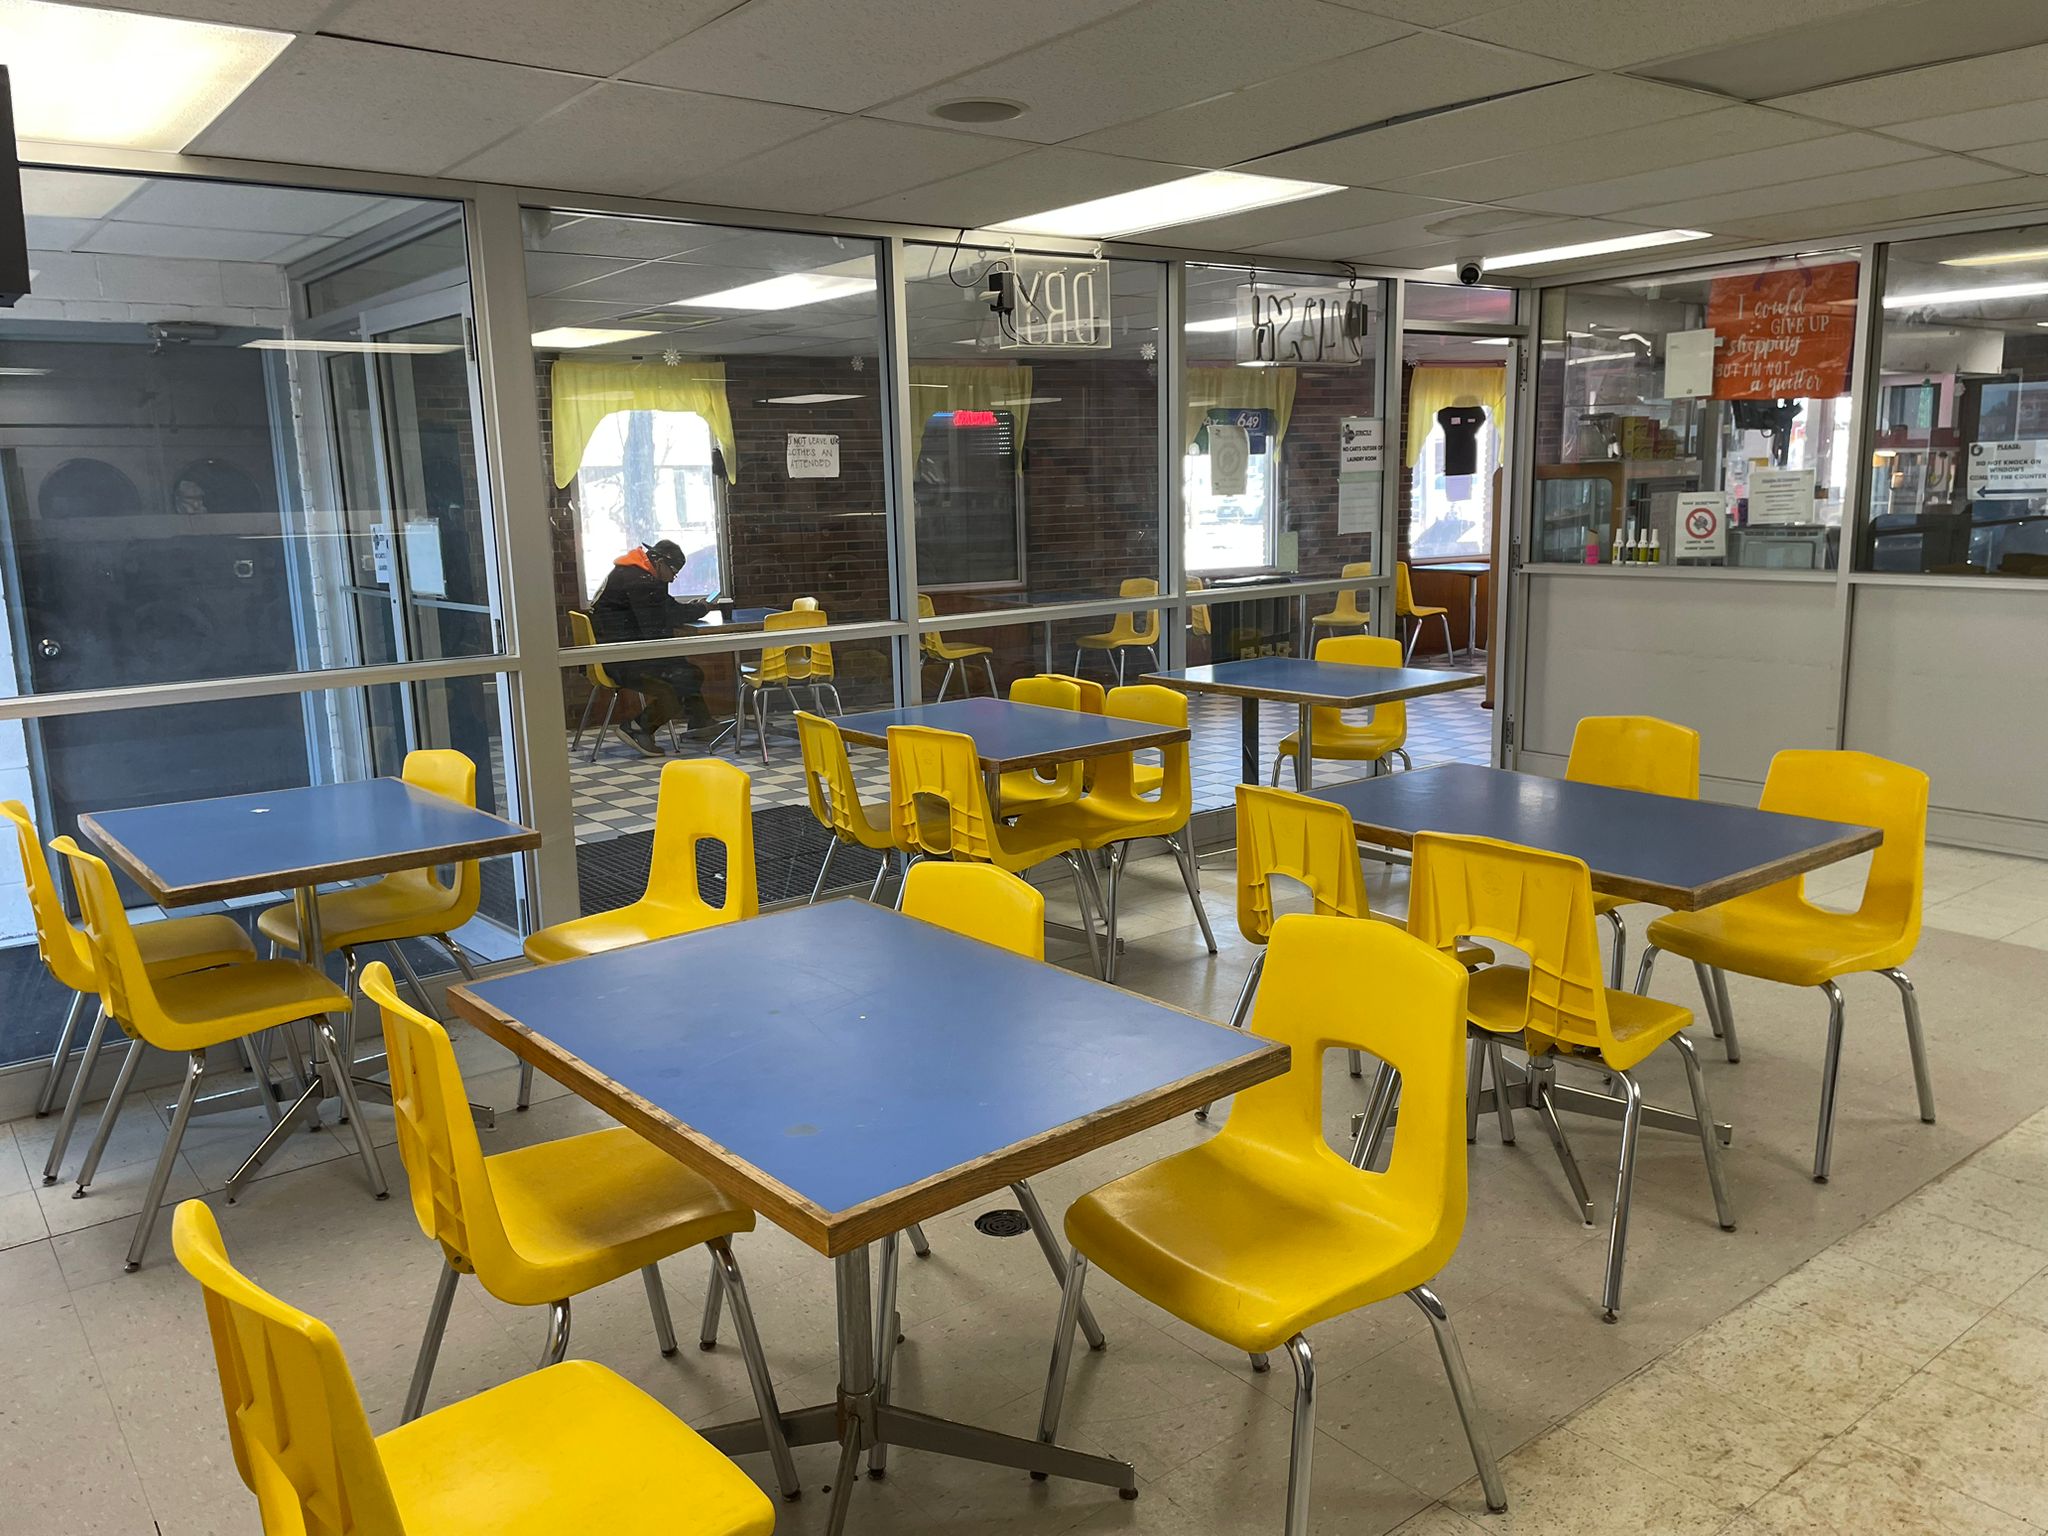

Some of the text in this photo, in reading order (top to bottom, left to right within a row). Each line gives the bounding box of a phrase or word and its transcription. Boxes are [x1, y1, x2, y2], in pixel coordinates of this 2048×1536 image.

[1738, 287, 1806, 320] I could
[1770, 315, 1829, 335] GIVE UP
[1727, 334, 1801, 360] shopping
[1715, 363, 1741, 378] BUT
[1744, 361, 1762, 377] I'M
[1750, 368, 1823, 399] a quitter
[2014, 472, 2047, 480] COUNTER
